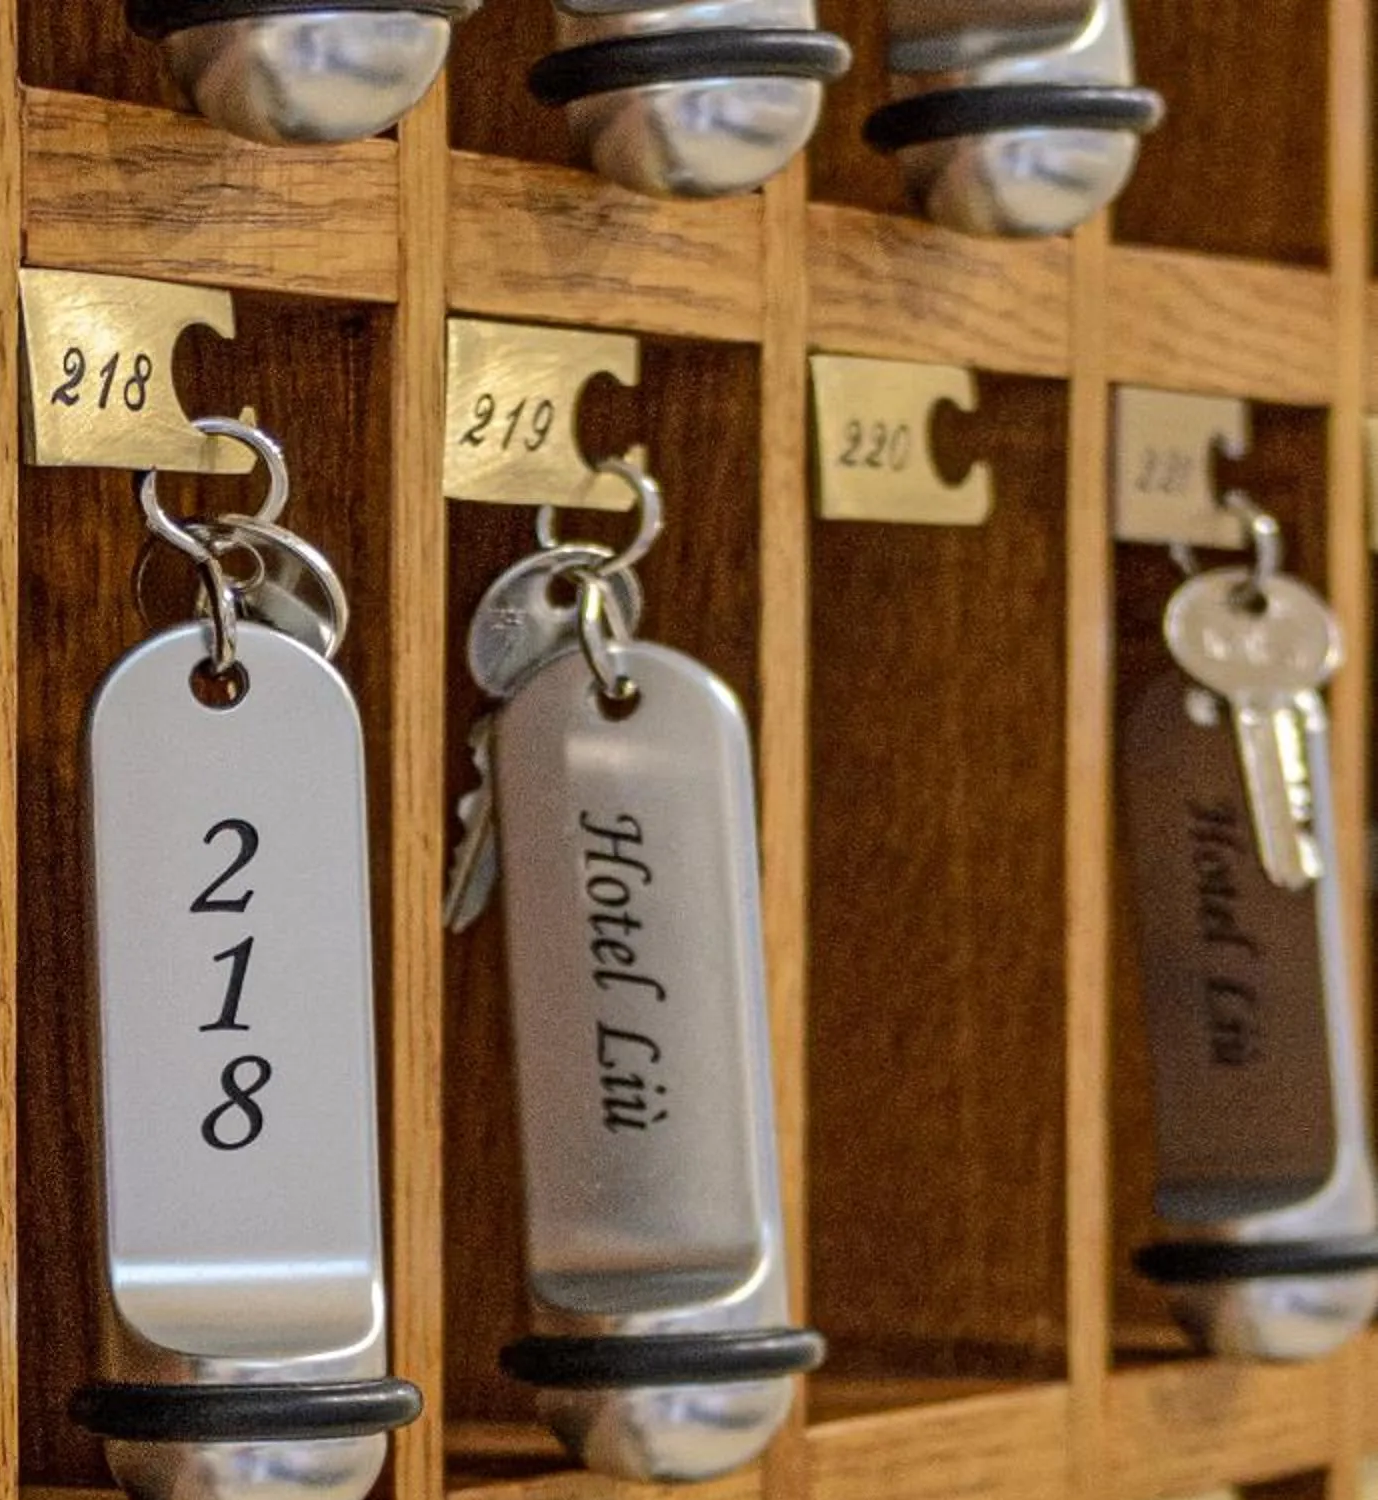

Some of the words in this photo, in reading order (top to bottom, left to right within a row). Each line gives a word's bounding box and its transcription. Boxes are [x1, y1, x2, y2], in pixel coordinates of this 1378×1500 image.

[50, 345, 154, 413] 218
[459, 391, 555, 454] 219
[836, 417, 912, 473] 220
[578, 809, 669, 1004] Hotel
[594, 1019, 670, 1135] Liù
